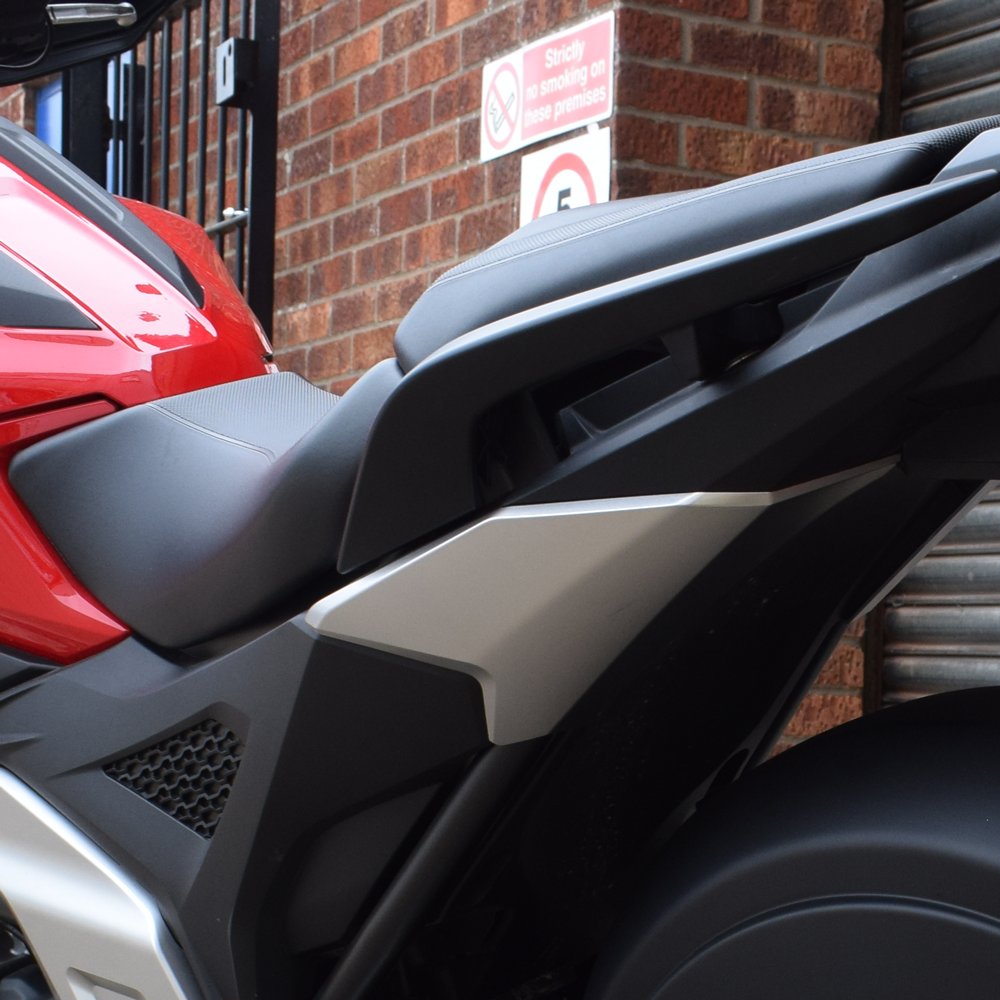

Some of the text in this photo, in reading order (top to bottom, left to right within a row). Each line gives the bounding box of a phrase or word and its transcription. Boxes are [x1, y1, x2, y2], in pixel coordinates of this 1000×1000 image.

[545, 39, 585, 69] Strictly
[525, 59, 606, 102] no smoking on
[523, 85, 607, 128] these premises
